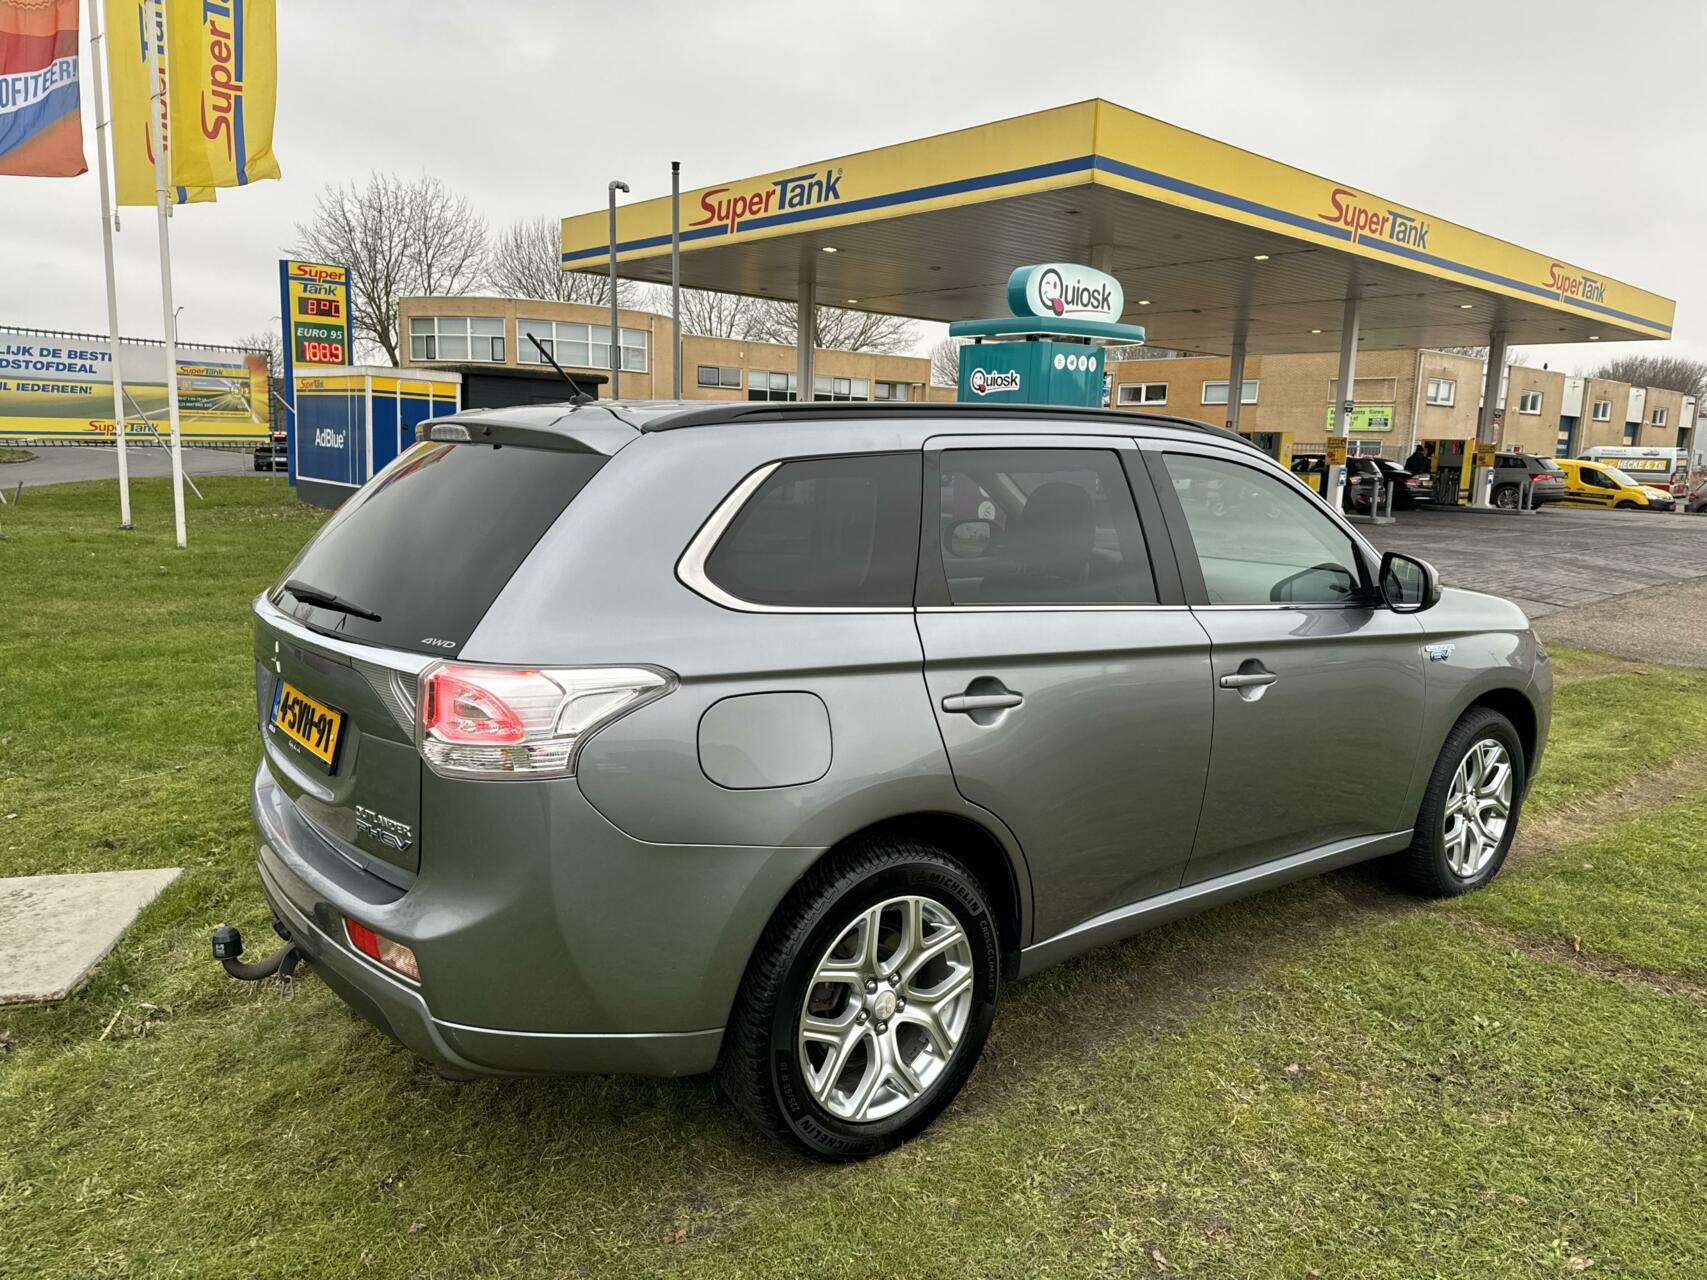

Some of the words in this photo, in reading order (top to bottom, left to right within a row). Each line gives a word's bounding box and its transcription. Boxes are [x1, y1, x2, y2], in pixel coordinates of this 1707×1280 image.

[201, 0, 243, 163] SuperT
[688, 169, 842, 234] SuperTank
[1318, 188, 1430, 250] SuperTank
[290, 264, 344, 283] Super
[1542, 262, 1605, 304] SuperTank
[298, 282, 337, 296] Tank
[1038, 267, 1112, 317] Quiosk
[297, 327, 328, 338] EURO
[330, 330, 343, 340] 95
[39, 347, 63, 359] DE
[16, 382, 93, 395] IEDEREEN!
[971, 369, 1019, 394] Quiosk
[82, 420, 159, 437] SuprTank
[421, 637, 457, 649] 4WD
[280, 691, 334, 754] 4-SVH-91
[928, 871, 981, 914] MICHELIN
